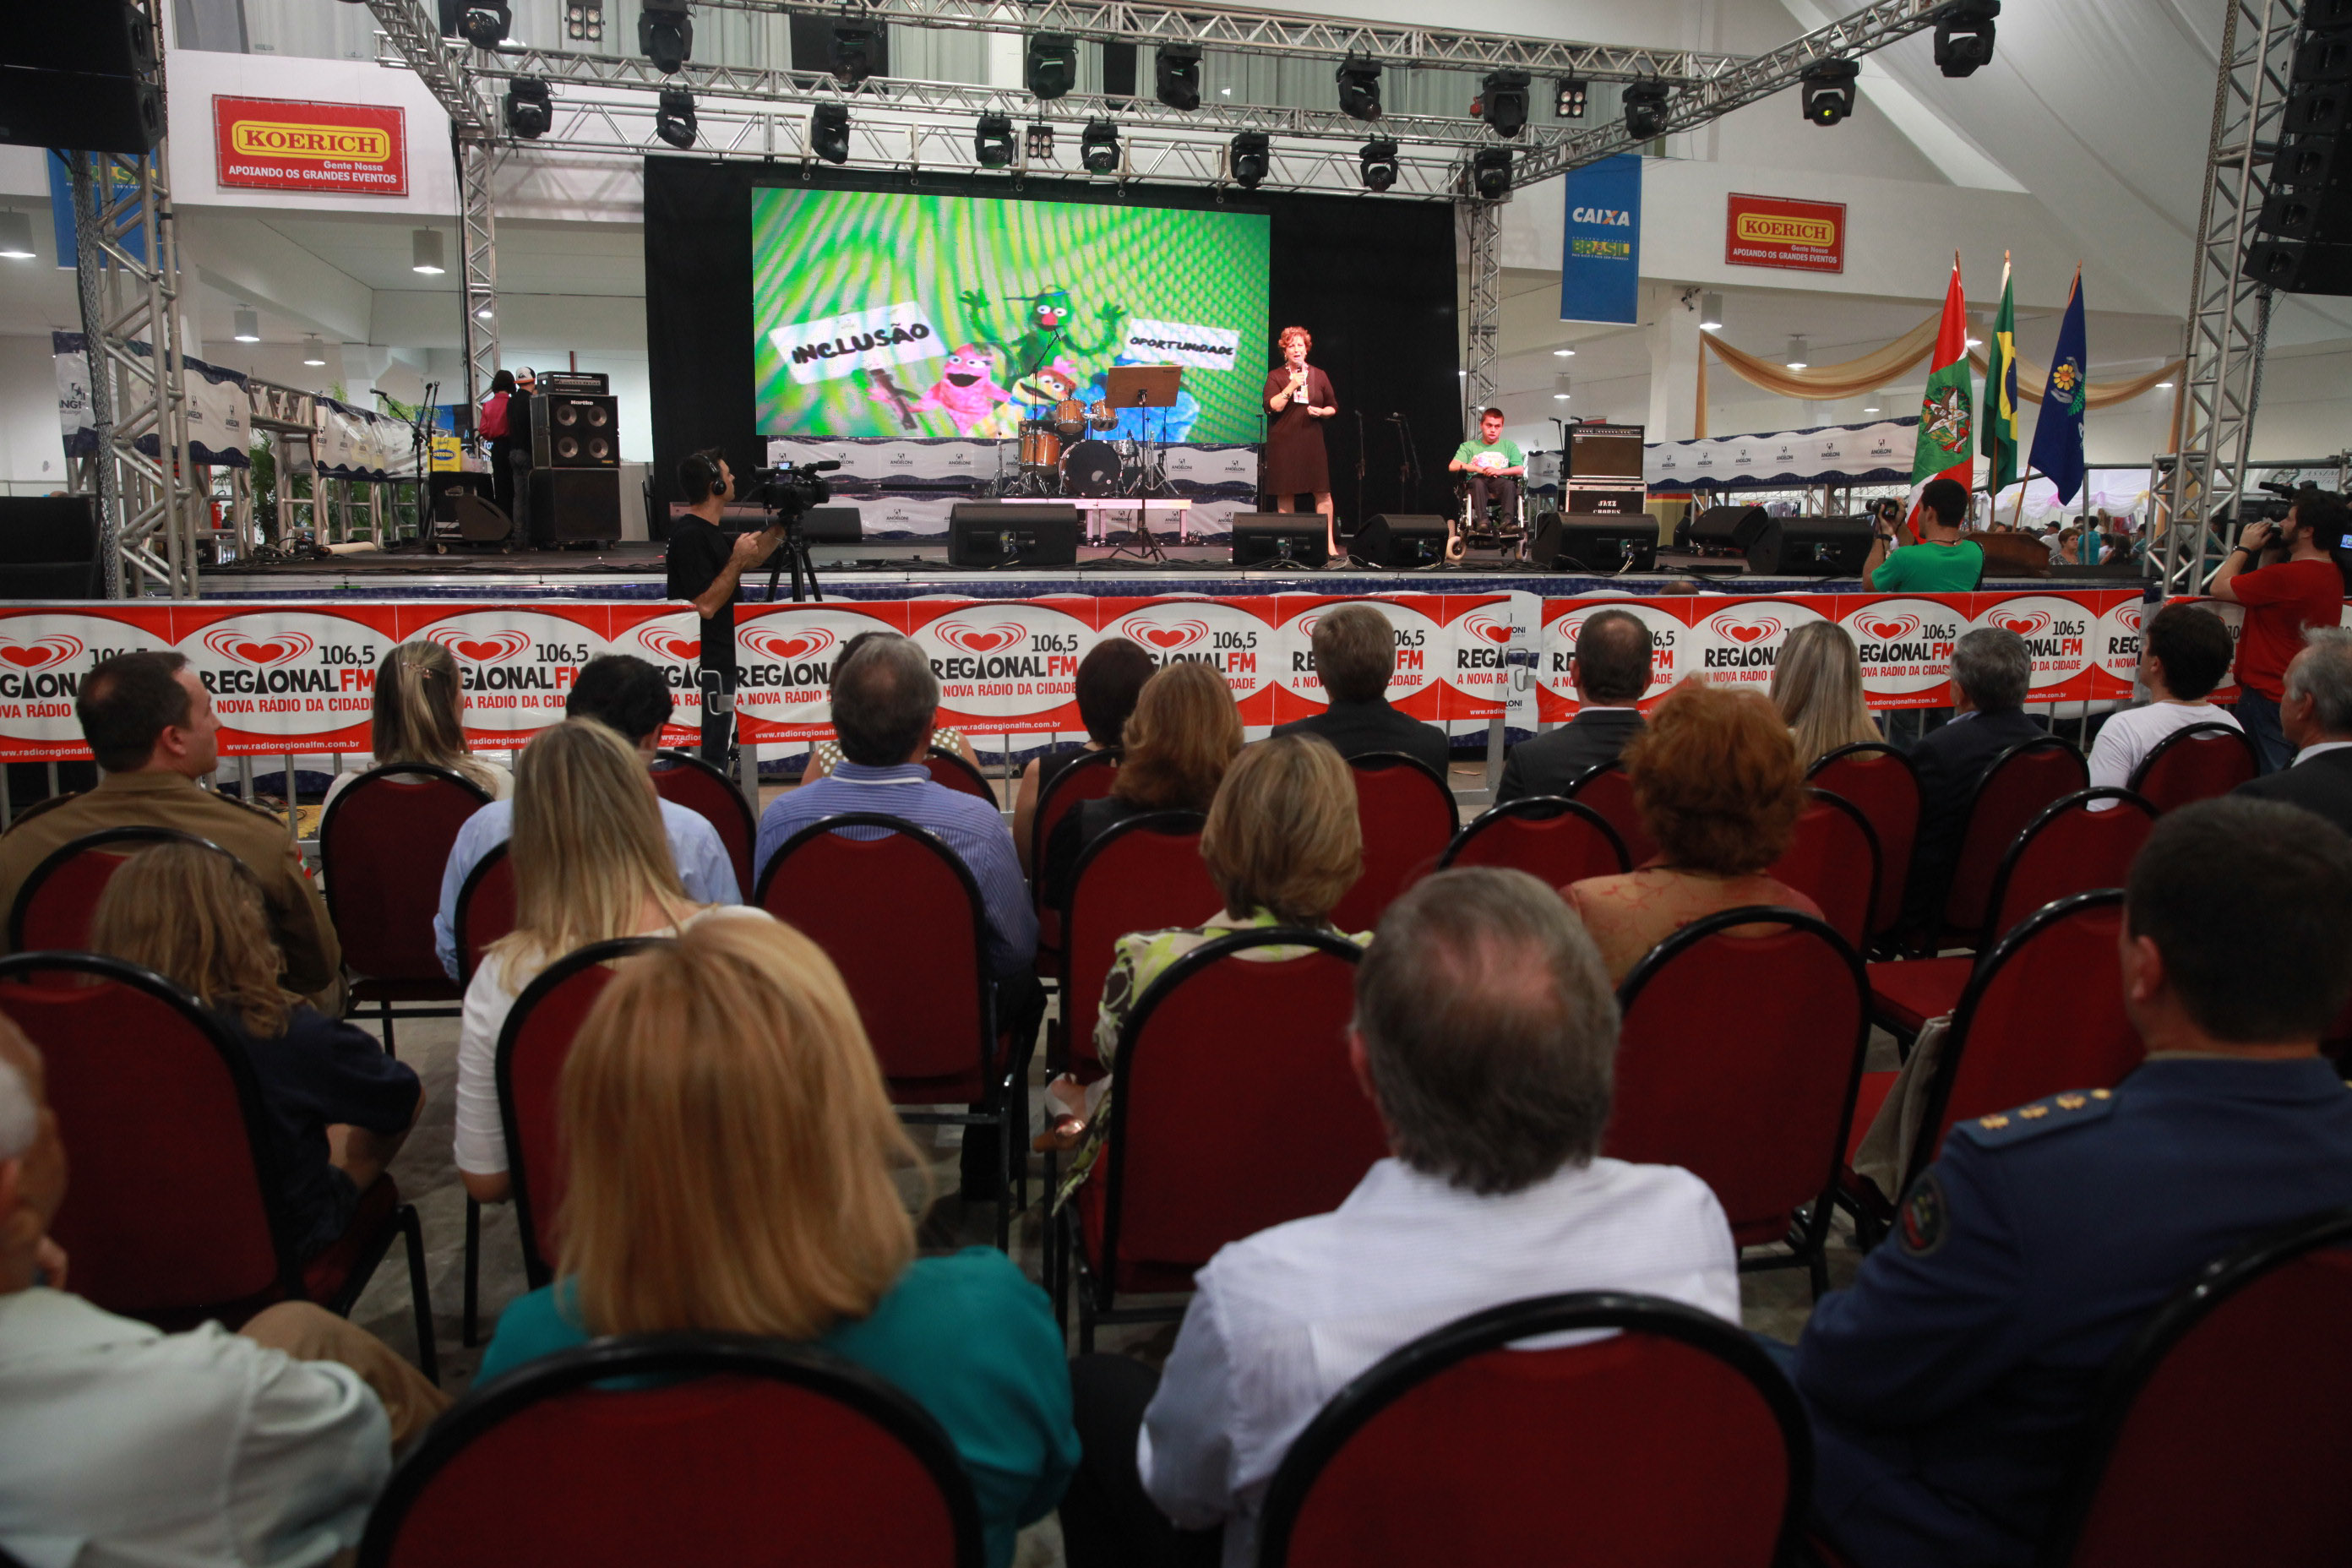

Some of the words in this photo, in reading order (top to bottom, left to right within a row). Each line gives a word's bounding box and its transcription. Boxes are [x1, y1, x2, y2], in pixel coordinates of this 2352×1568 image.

[244, 129, 378, 154] KOERICH
[229, 165, 284, 177] APOIANDO
[286, 168, 300, 178] OS
[302, 170, 350, 182] GRANDES
[352, 172, 397, 183] EVENTOS
[324, 161, 352, 171] Gente
[355, 162, 384, 172] Nossa
[1572, 207, 1630, 226] CAIXA
[1745, 220, 1827, 239] KOERICH
[1572, 240, 1630, 257] BRASIL
[1733, 248, 1767, 259] APOIANDO
[1779, 252, 1808, 262] GRANDES
[1810, 254, 1838, 264] EVENTOS
[1791, 244, 1809, 253] Gente
[792, 322, 929, 364] INCLUSÃO
[1130, 336, 1233, 356] OPORTUNIDADE
[1922, 624, 1956, 642] 106,5
[2052, 621, 2085, 638] 106,5
[1032, 634, 1078, 655] 106,5
[1213, 632, 1257, 652] 106,5
[1394, 629, 1425, 650] 06,5
[1652, 630, 1674, 650] 6,5
[319, 645, 376, 667] 106,5
[536, 644, 589, 666] 106,5
[1397, 650, 1424, 670] FM
[1704, 645, 1781, 667] REGION
[1859, 641, 1931, 663] EGIONAL
[1861, 667, 1878, 678] OVA
[1881, 663, 1906, 677] RÁDIO
[1908, 665, 1920, 676] DA
[2039, 662, 2050, 672] DA
[2053, 660, 2081, 671] CIDADE
[2115, 658, 2136, 668] NOVA
[737, 661, 830, 688] REGION
[1293, 677, 1299, 688] A
[1457, 673, 1463, 684] A
[1467, 672, 1493, 684] NOVA
[1552, 677, 1559, 688] A
[1713, 672, 1737, 683] NOVA
[1740, 668, 1767, 682] RÁDIO
[749, 692, 781, 705] NOVA
[785, 688, 822, 703] RÁDIO
[943, 684, 974, 697] NOVA
[978, 681, 1013, 696] RÁDIO
[1017, 683, 1032, 695] DA
[26, 700, 71, 717] RÁDIO
[217, 699, 254, 713] NOVA
[259, 695, 301, 712] RÁDIO
[306, 698, 324, 711] DA
[477, 693, 517, 709] RÁDIO
[522, 695, 539, 708] DA
[227, 740, 360, 751] www.radioregionalfm.com.br
